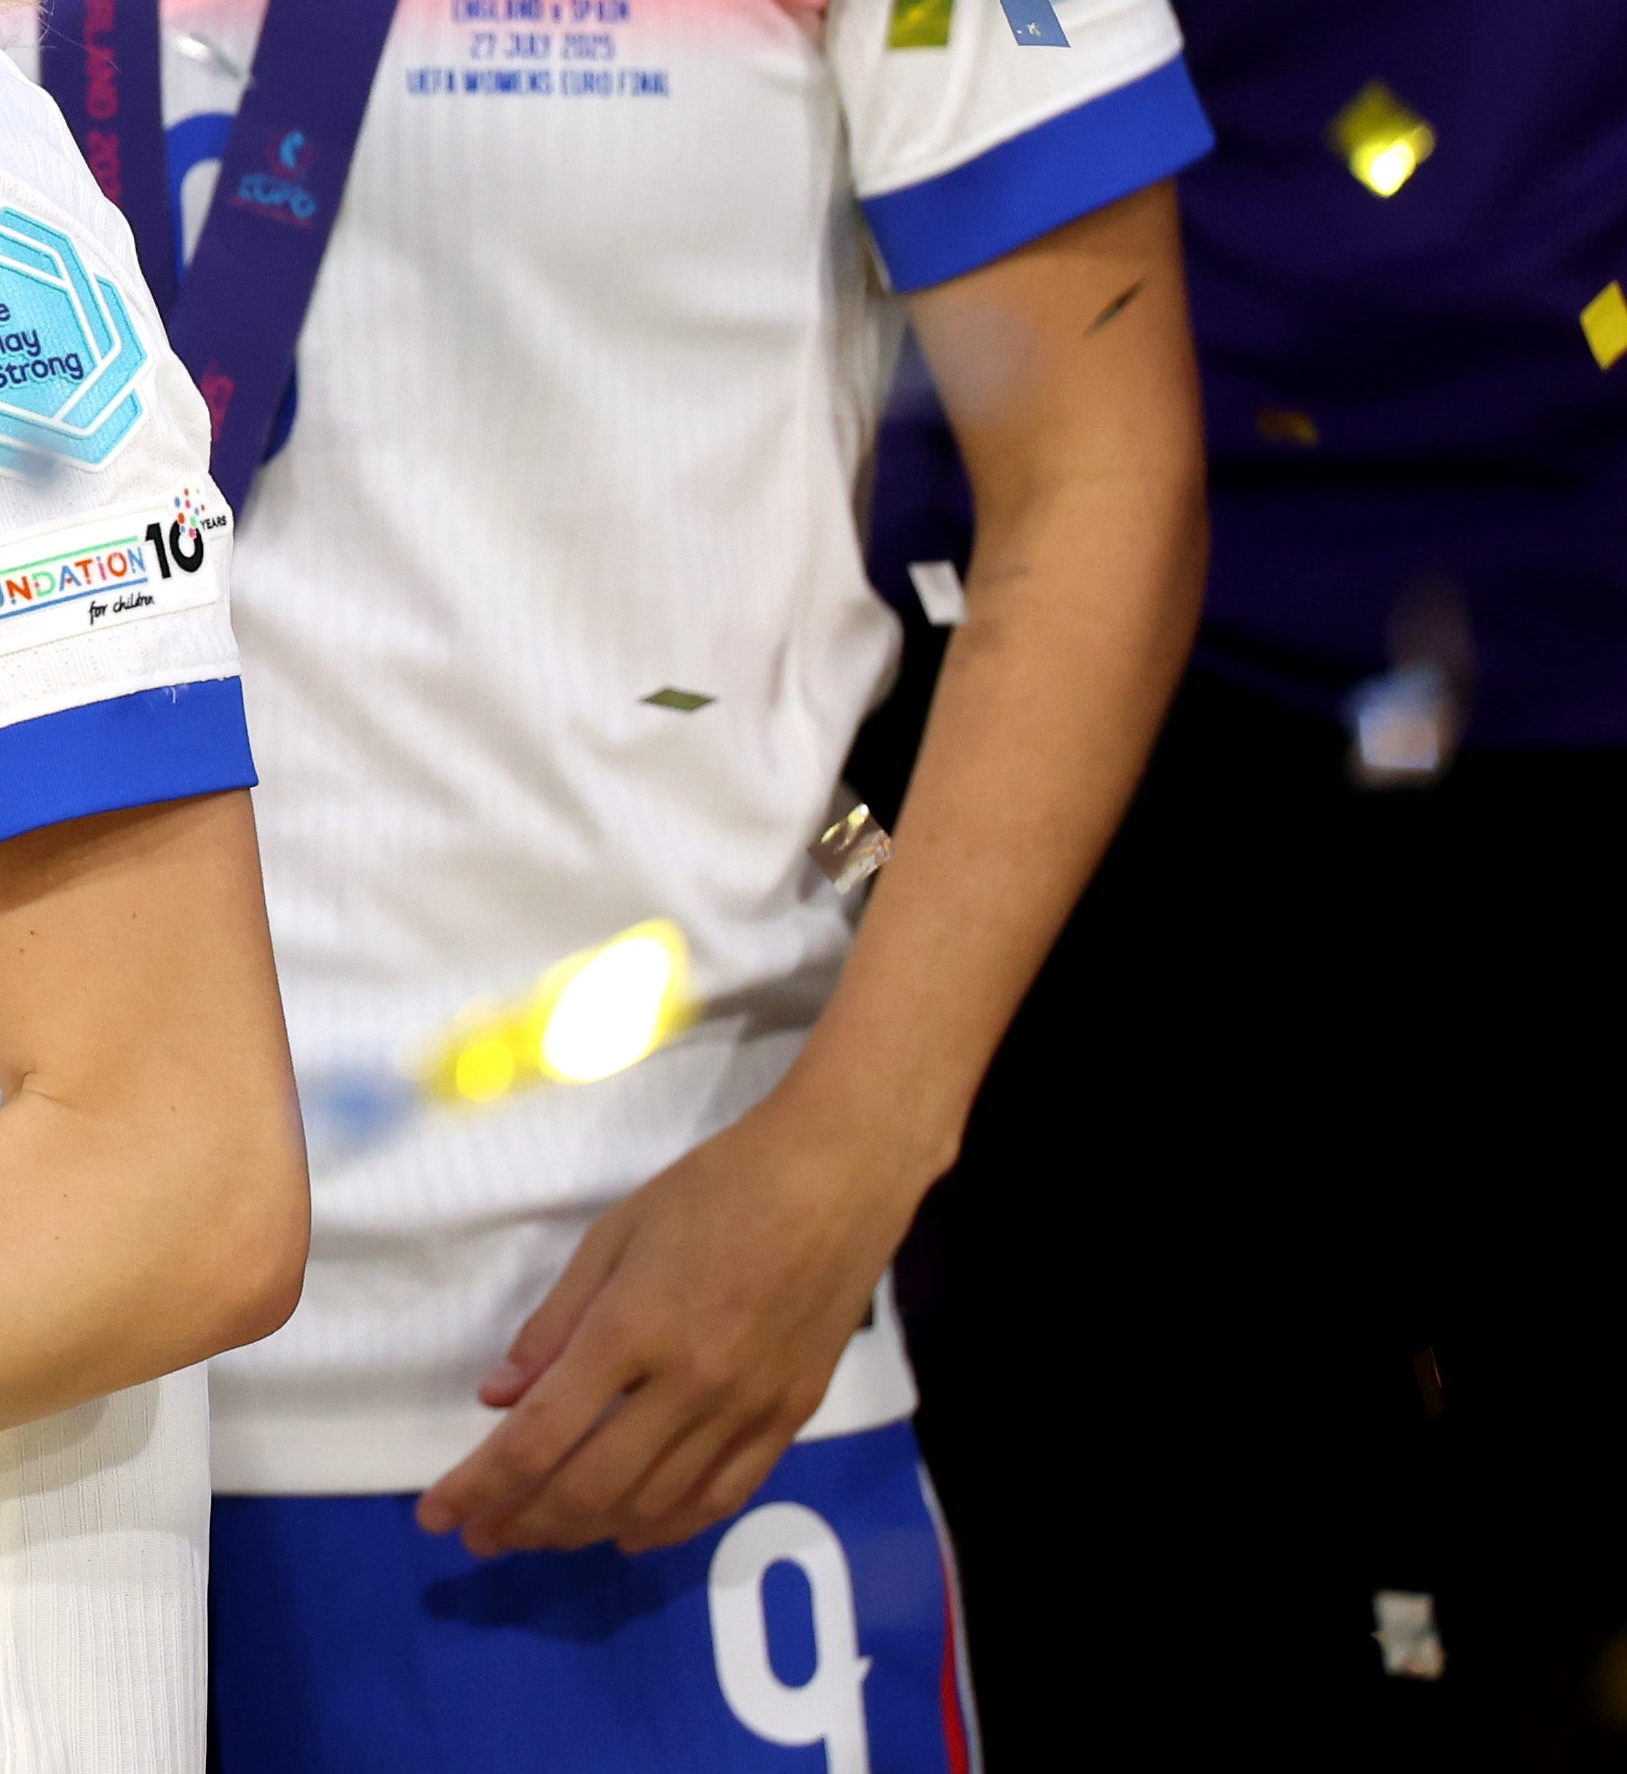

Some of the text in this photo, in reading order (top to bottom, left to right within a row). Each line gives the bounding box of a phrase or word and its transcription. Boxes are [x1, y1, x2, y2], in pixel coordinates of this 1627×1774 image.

[503, 31, 550, 60] JULY
[562, 32, 616, 61] 2025
[407, 68, 457, 98] UEFA
[145, 519, 204, 580] 10
[199, 515, 227, 530] YEARS
[89, 592, 155, 625] for children
[708, 1500, 873, 1774] 9
